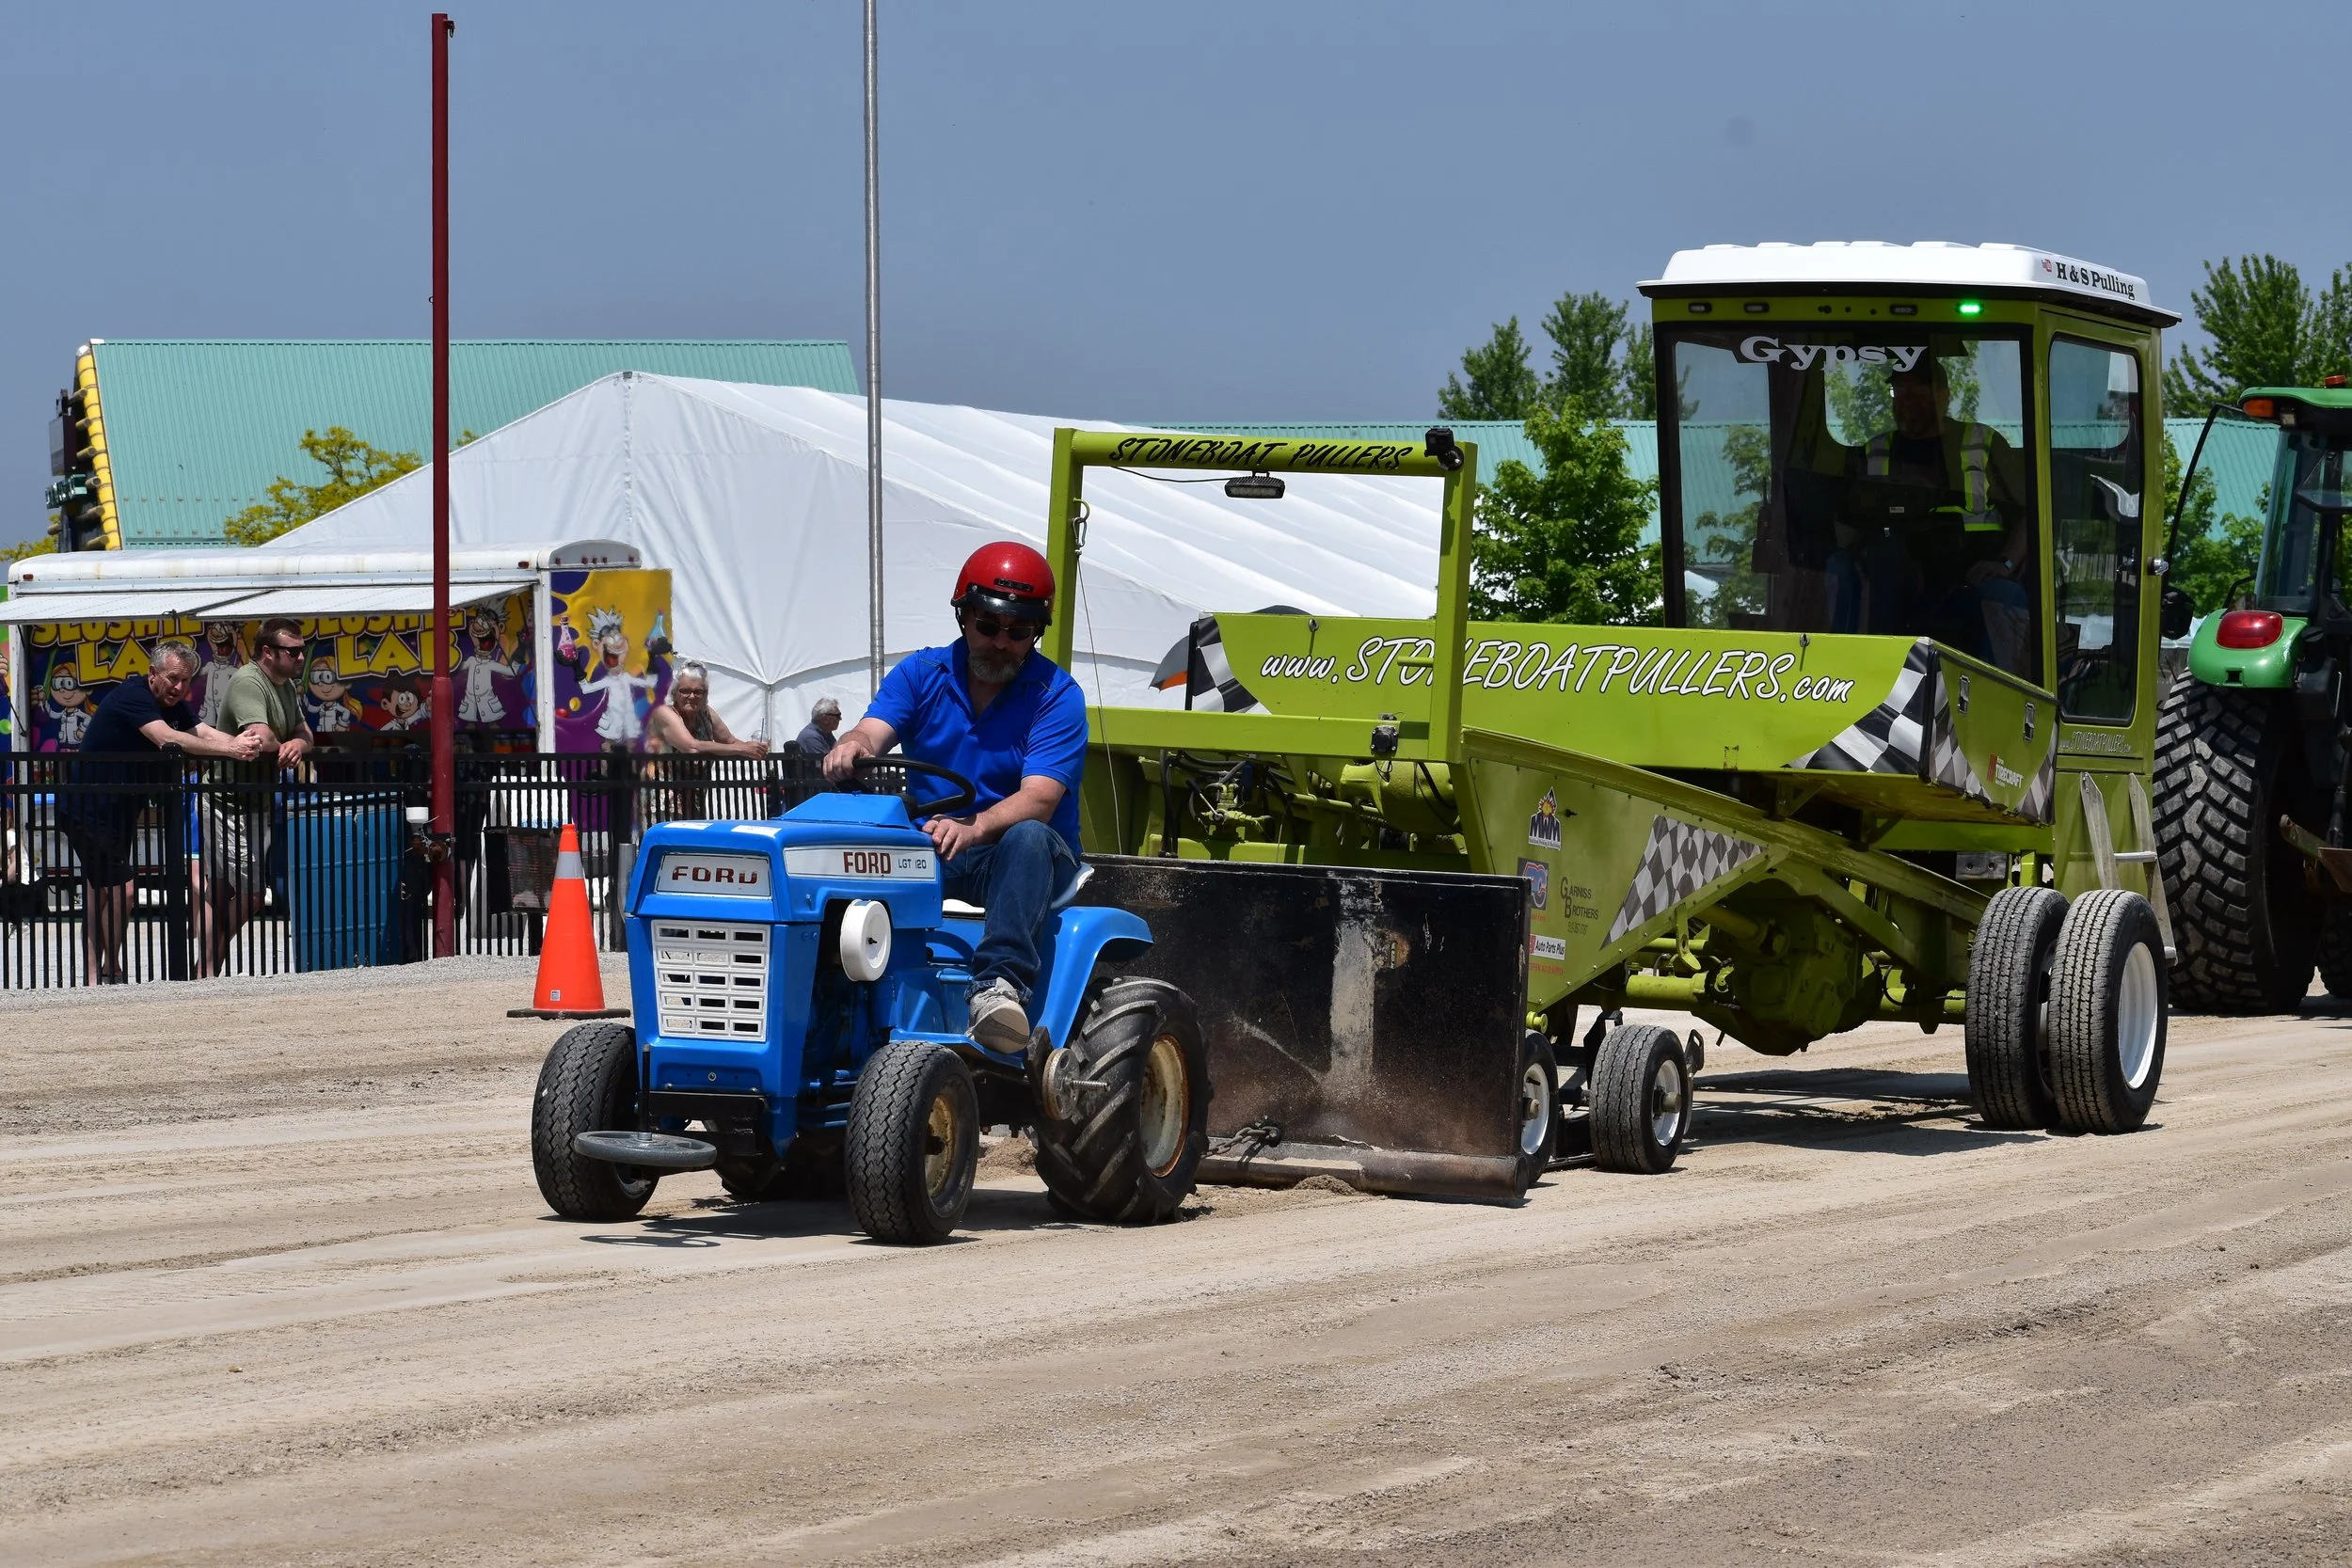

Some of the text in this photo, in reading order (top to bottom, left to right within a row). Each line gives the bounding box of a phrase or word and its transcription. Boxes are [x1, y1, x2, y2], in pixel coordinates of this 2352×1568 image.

[2056, 262, 2068, 280] H
[2070, 265, 2079, 283] &
[2080, 267, 2090, 285] S
[2090, 271, 2136, 300] Pulling
[1740, 335, 1929, 372] Gypsy
[1108, 437, 1413, 469] STONEBOAT PULLERS
[843, 851, 892, 875] FORD
[898, 858, 927, 869] LGT 120
[1561, 877, 1592, 899] GARNISS
[1565, 896, 1599, 920] BROTHERS
[1535, 940, 1546, 952] Auto
[1546, 942, 1556, 954] Parts
[1556, 943, 1565, 956] Plus
